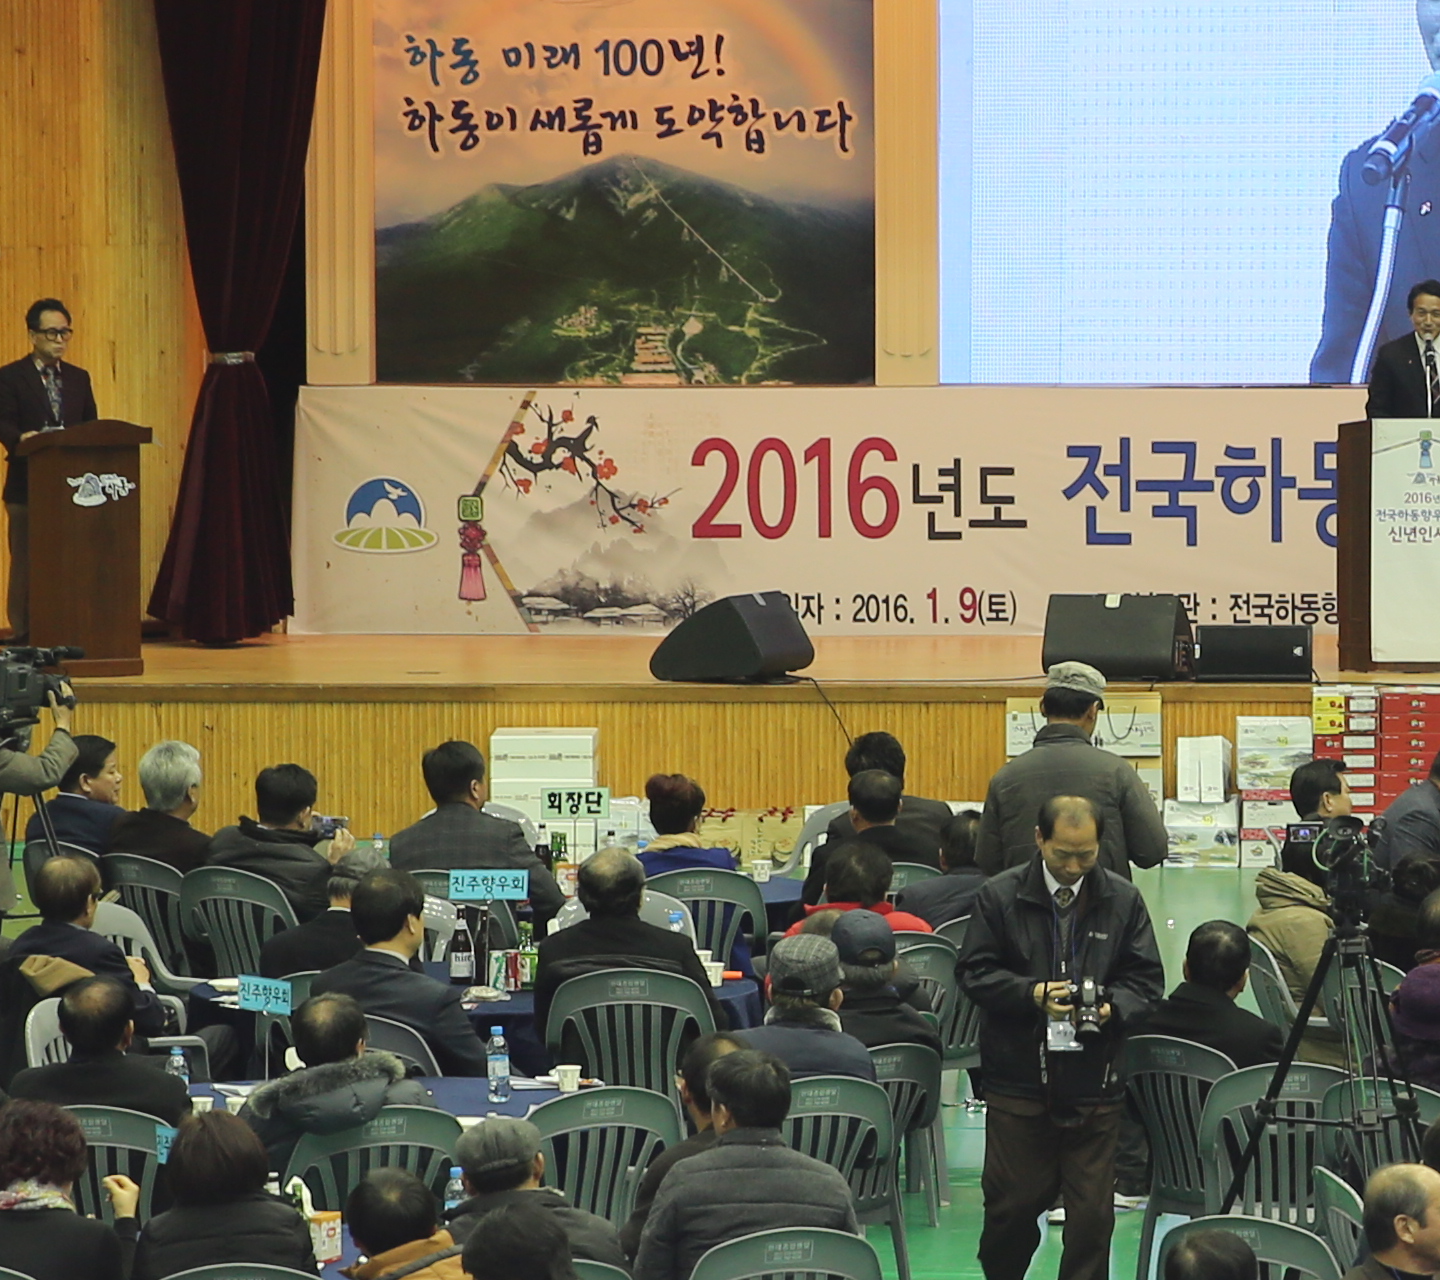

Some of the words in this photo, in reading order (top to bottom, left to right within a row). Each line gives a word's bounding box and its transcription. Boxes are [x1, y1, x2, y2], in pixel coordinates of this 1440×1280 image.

[404, 34, 481, 87] 하동
[503, 39, 581, 72] 미래
[594, 33, 726, 79] 100년!
[402, 96, 517, 153] 하동이
[528, 97, 639, 156] 새롭게
[655, 93, 854, 154] 도약합니다
[689, 436, 1028, 543] 2016년도
[852, 593, 915, 623] 2016.
[546, 789, 603, 815] 회장단
[451, 873, 527, 895] 진주향우회
[238, 981, 291, 1007] 진주향우회
